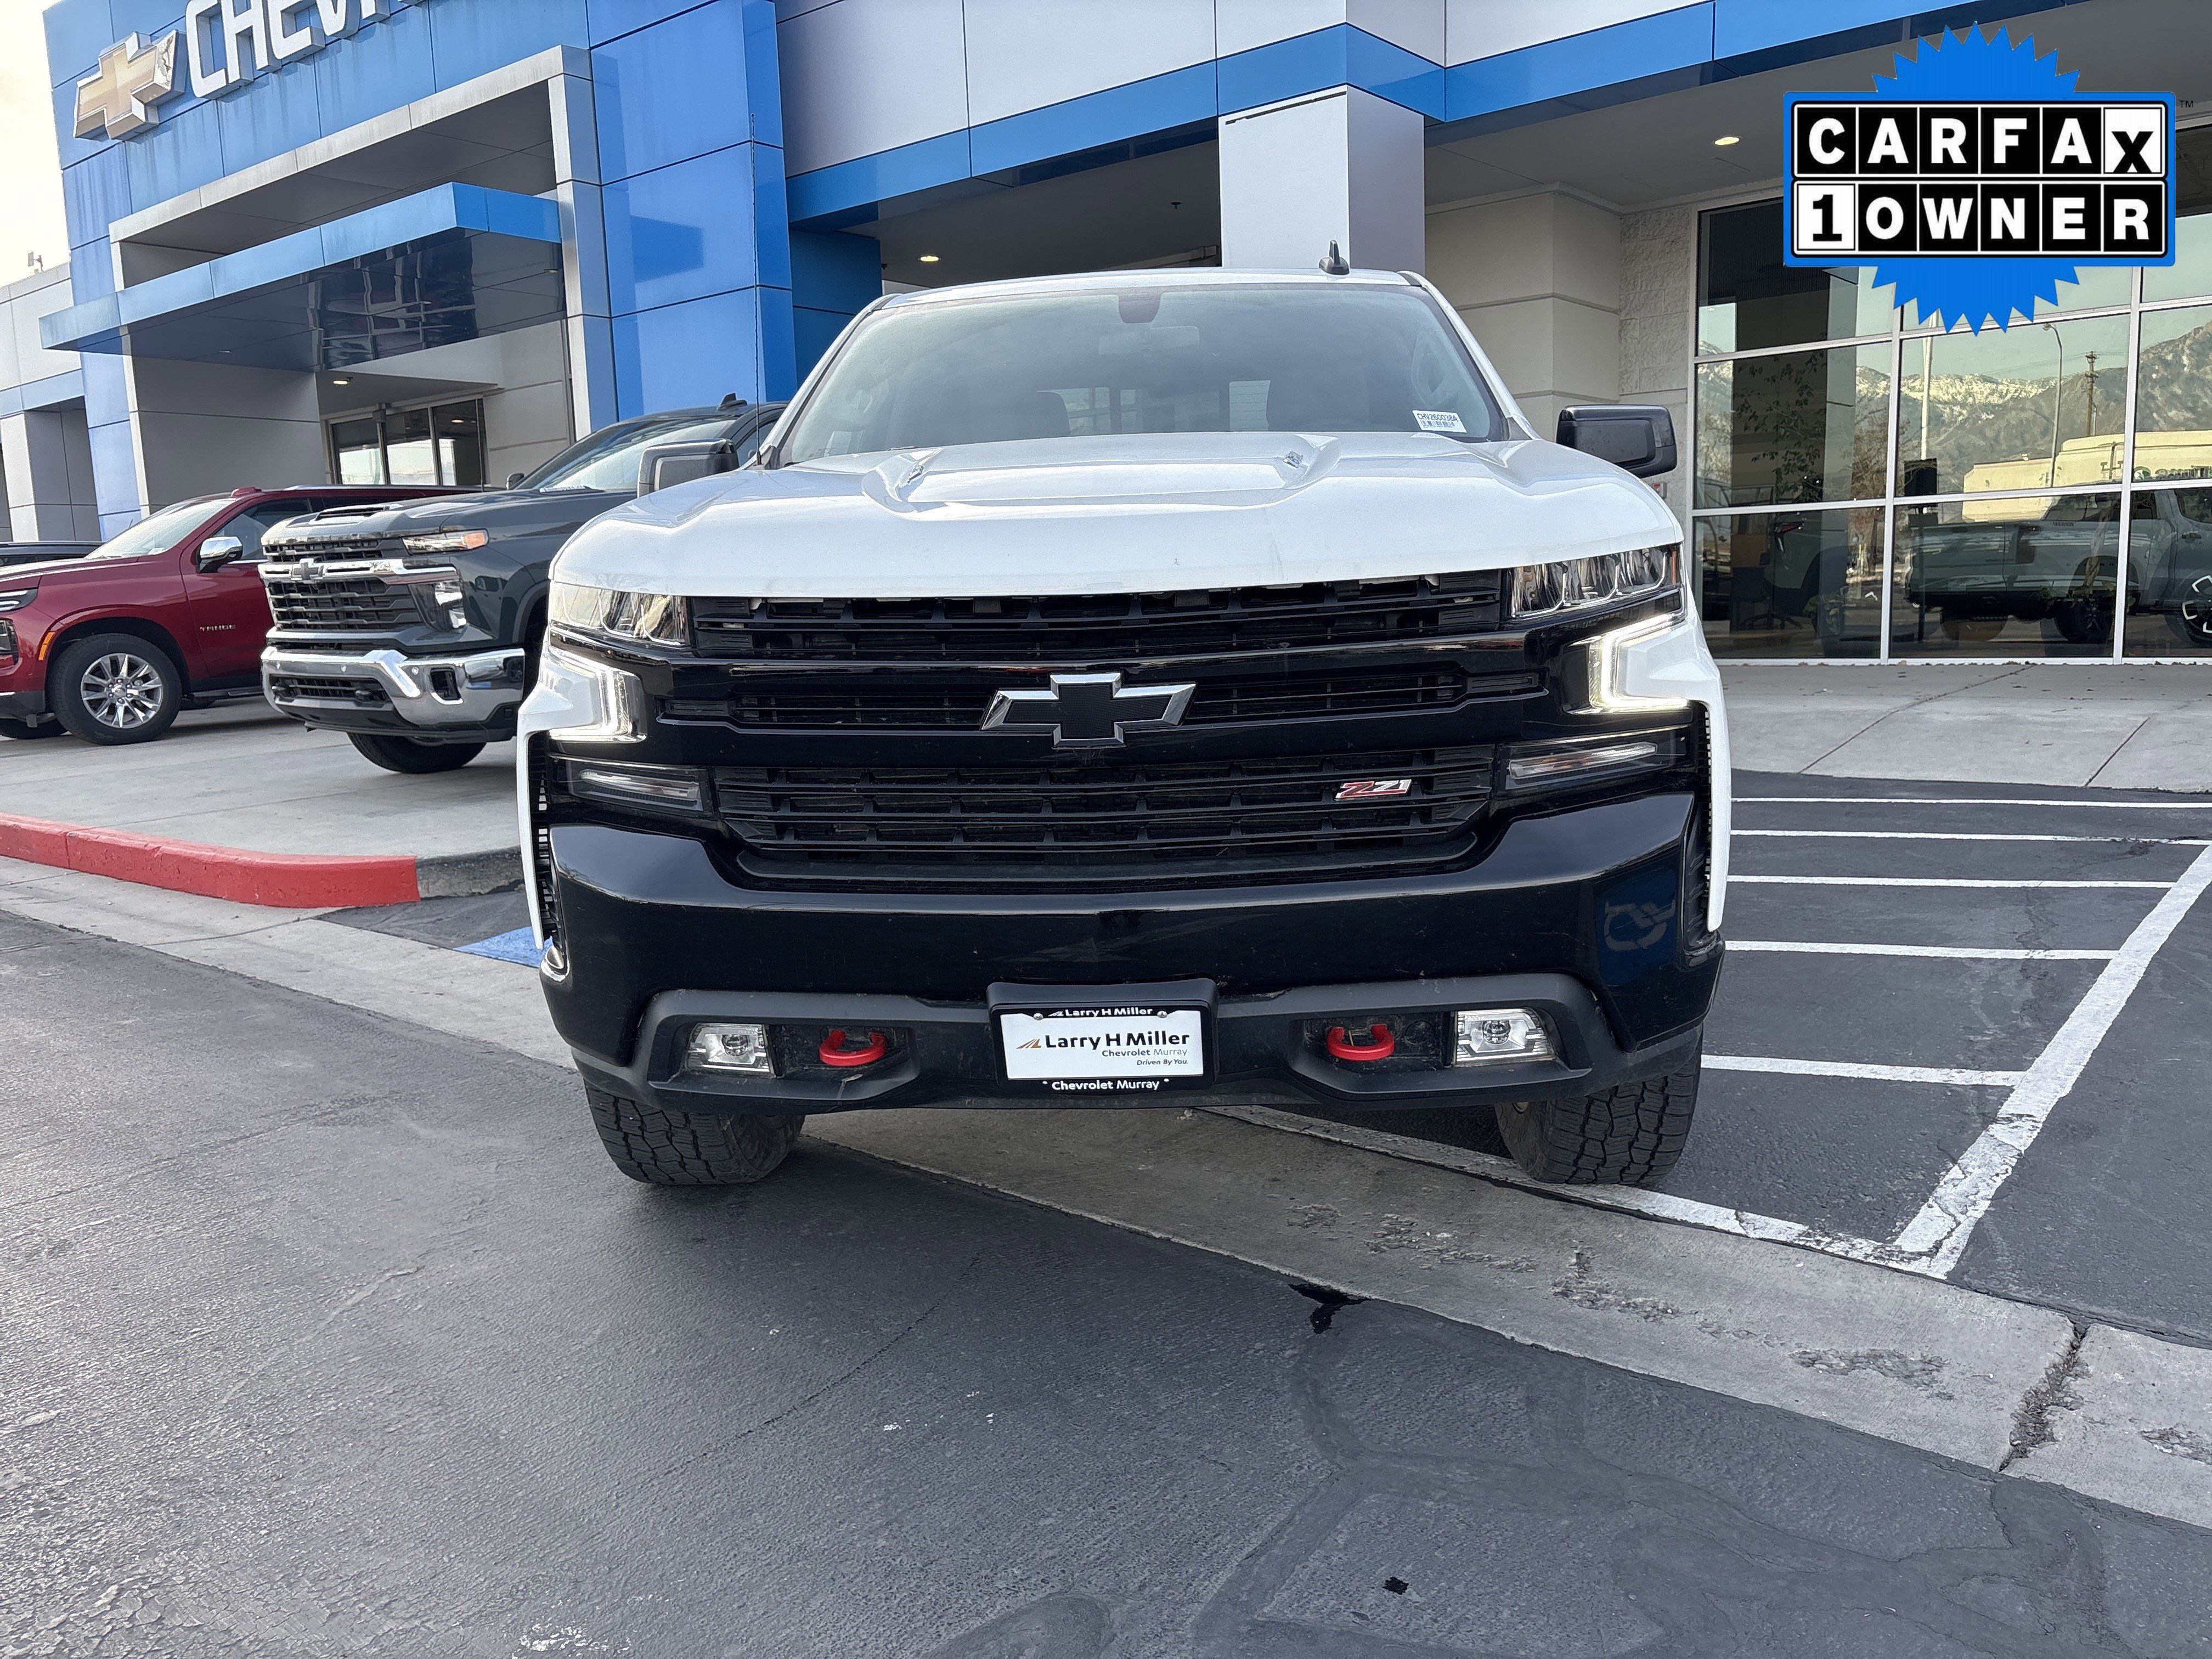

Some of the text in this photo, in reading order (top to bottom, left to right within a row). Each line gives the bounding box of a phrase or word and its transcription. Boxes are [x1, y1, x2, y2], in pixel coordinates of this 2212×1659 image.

[1335, 778, 1412, 799] Z71
[1114, 1007, 1153, 1016] Miller
[1045, 1030, 1190, 1050] Larry H Miller
[1102, 1048, 1188, 1057] Chevrolet Murray
[1052, 1080, 1160, 1090] Chevrolet Murray
